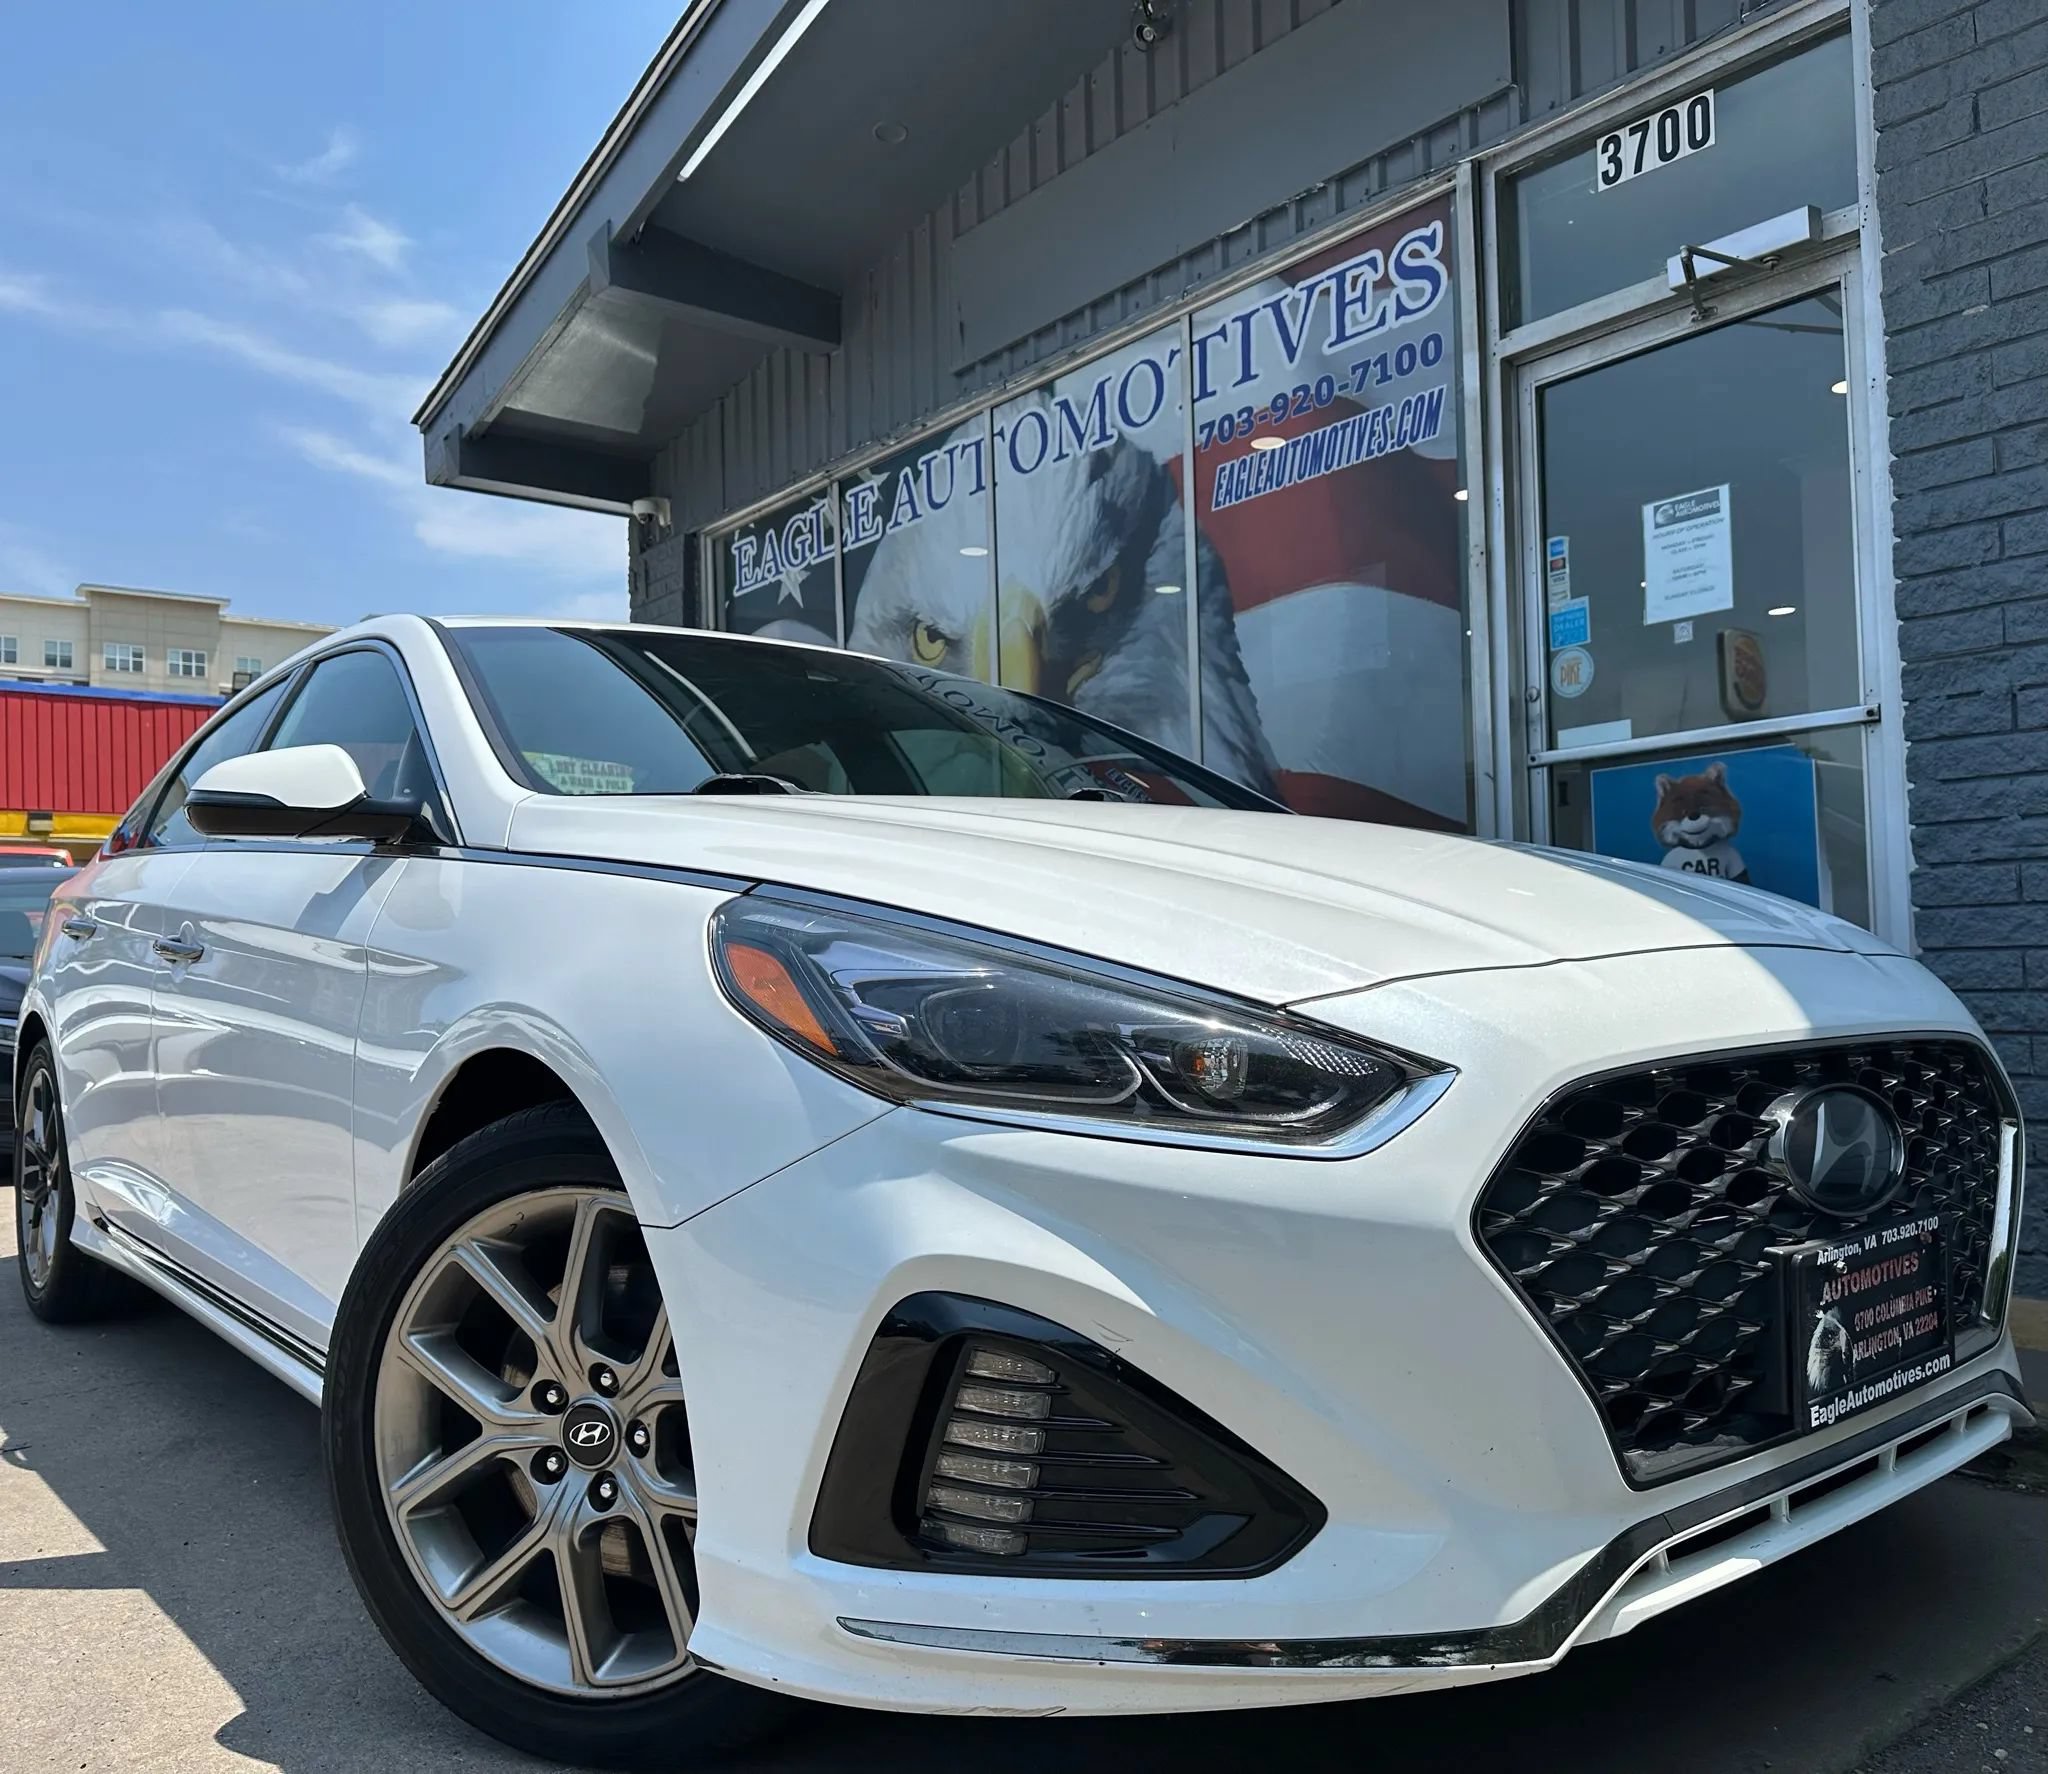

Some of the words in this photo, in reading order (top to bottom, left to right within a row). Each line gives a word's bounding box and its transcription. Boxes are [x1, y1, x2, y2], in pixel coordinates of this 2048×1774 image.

[1601, 95, 1711, 186] 3700
[733, 481, 883, 597] EAGLE
[887, 220, 1448, 533] AUTOMOTIVES
[1199, 332, 1444, 452] 703-920-7100
[1211, 384, 1447, 511] EAGLEAUTOMOTIVES.COM
[1681, 858, 1720, 876] CAR
[1817, 1243, 1862, 1266] Arlington,
[1864, 1235, 1877, 1250] VA
[1881, 1216, 1939, 1245] 703.920.7100
[1822, 1252, 1919, 1304] AUTOMOTIVES
[1903, 1321, 1914, 1341] VA
[1810, 1354, 1950, 1428] EagleAutomotives.com
